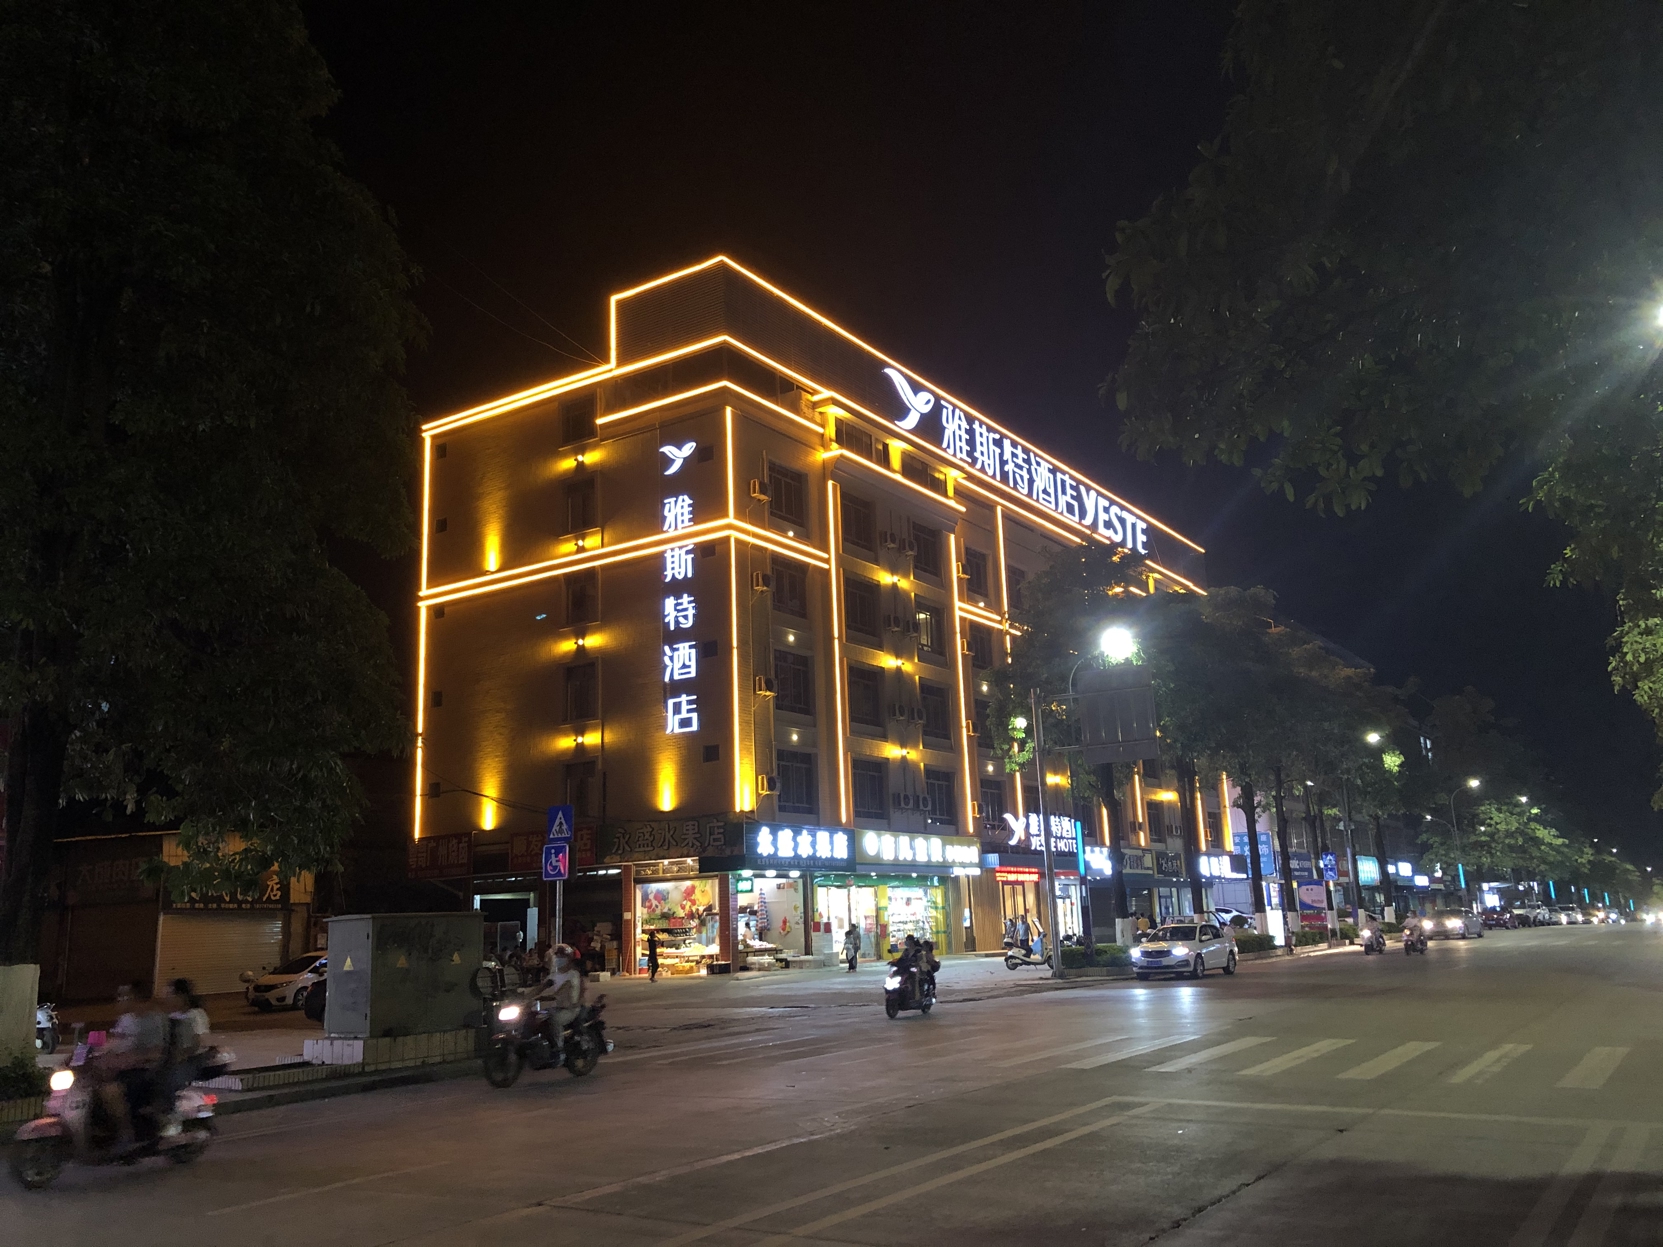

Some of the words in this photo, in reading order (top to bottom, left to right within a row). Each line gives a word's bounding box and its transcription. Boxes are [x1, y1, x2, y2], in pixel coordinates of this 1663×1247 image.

[941, 400, 1079, 523] 雅斯特酒店
[1079, 484, 1148, 554] YESTE
[663, 494, 698, 734] 雅斯特酒店
[612, 818, 727, 855] 永盛水果店
